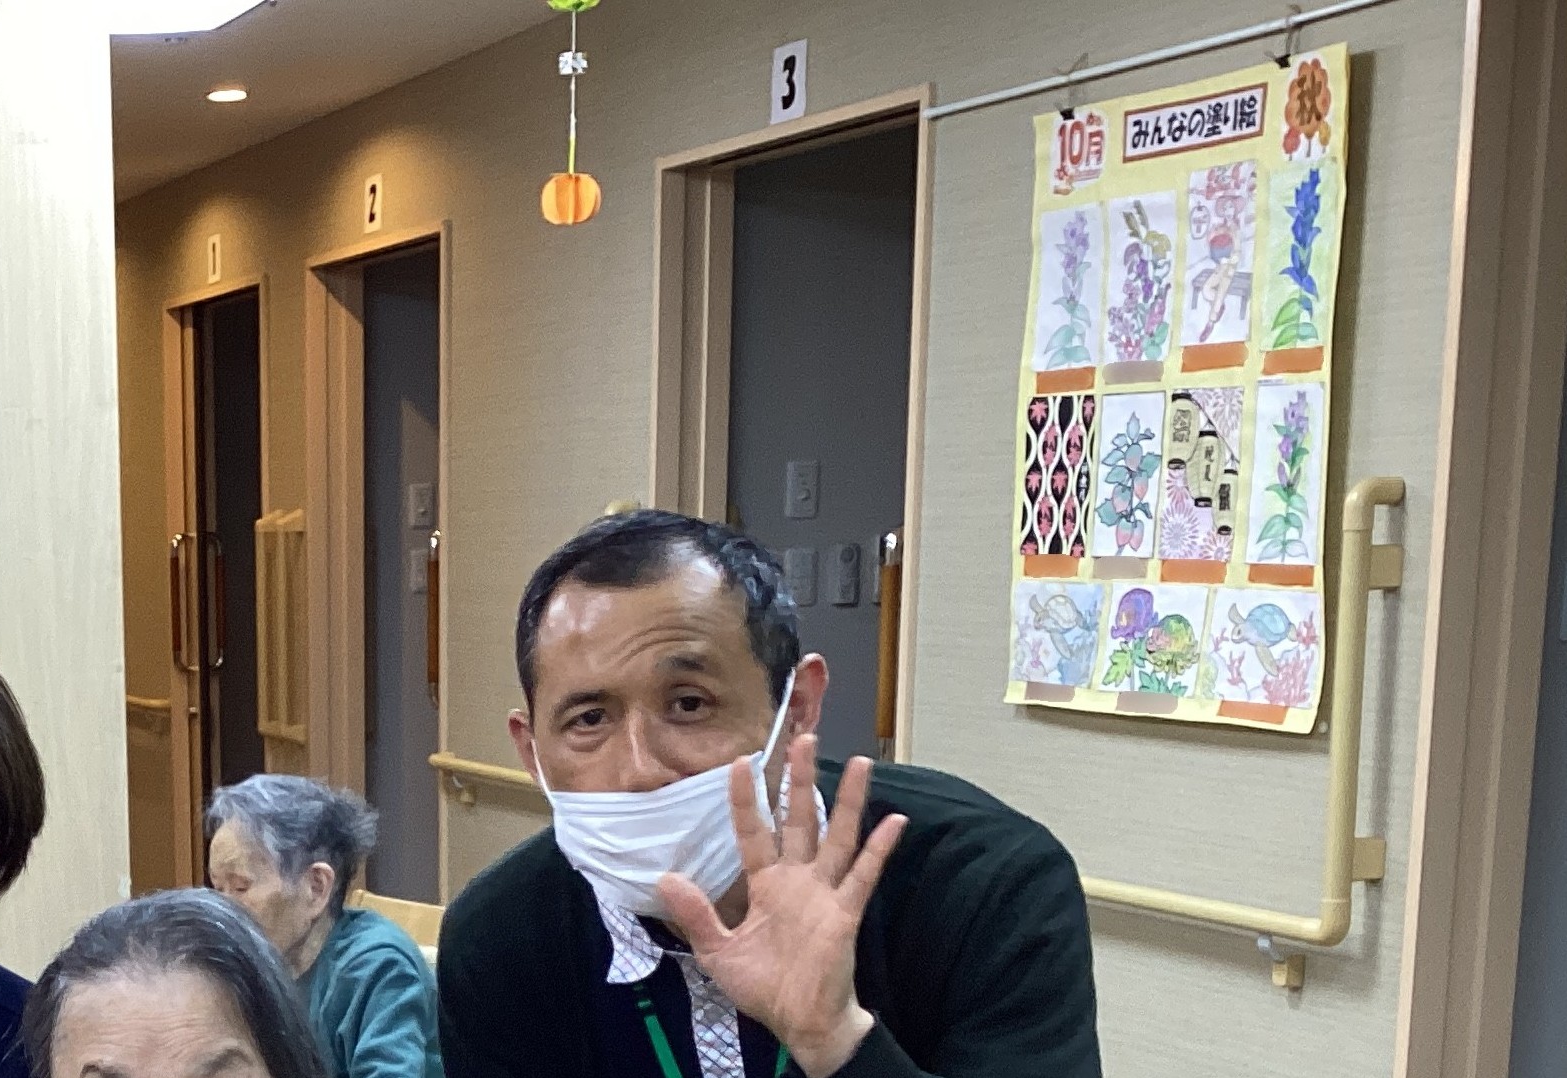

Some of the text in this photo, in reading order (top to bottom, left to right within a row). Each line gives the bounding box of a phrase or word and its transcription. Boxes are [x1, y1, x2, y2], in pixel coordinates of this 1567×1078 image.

[781, 54, 796, 110] 3
[1296, 70, 1323, 126] 秋
[1058, 118, 1104, 167] 10月
[1131, 94, 1258, 149] みんなの塗り絵
[368, 183, 377, 224] 2
[211, 242, 216, 275] 1
